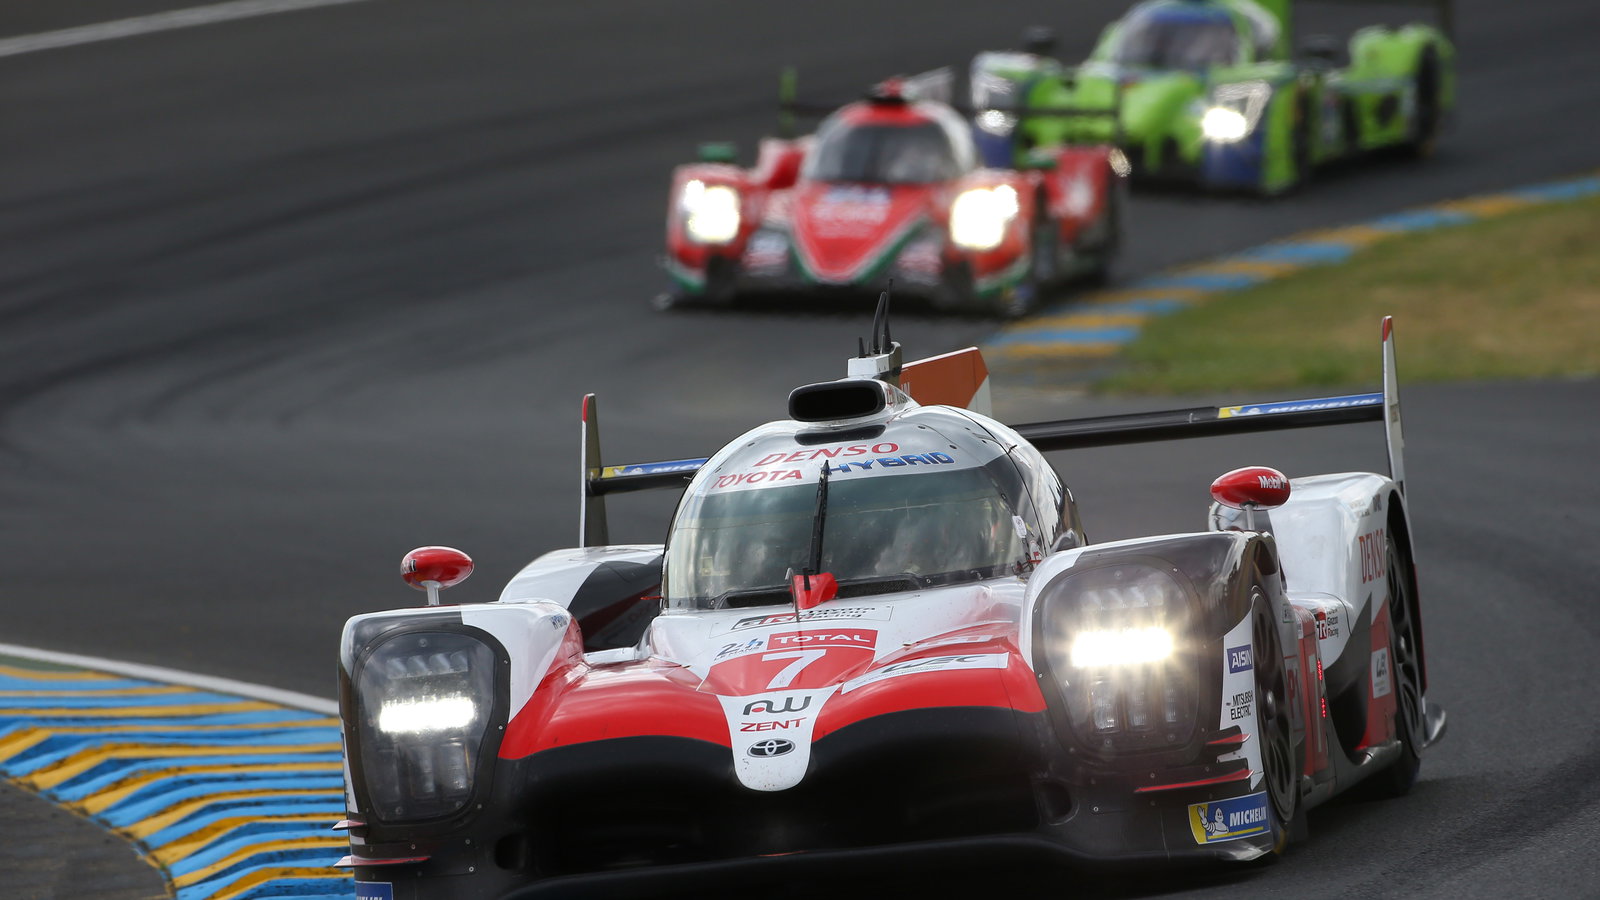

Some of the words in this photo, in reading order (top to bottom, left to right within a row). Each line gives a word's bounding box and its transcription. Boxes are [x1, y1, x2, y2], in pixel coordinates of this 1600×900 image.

[753, 442, 900, 468] DENSO
[827, 451, 956, 476] HYBRID
[710, 470, 804, 490] TOYOTA
[1258, 475, 1281, 489] Mobil
[774, 634, 871, 645] TOTAL
[1232, 649, 1252, 669] AISIN
[761, 649, 827, 690] 7
[740, 717, 807, 732] ZENT
[1229, 806, 1267, 827] MICHELIN
